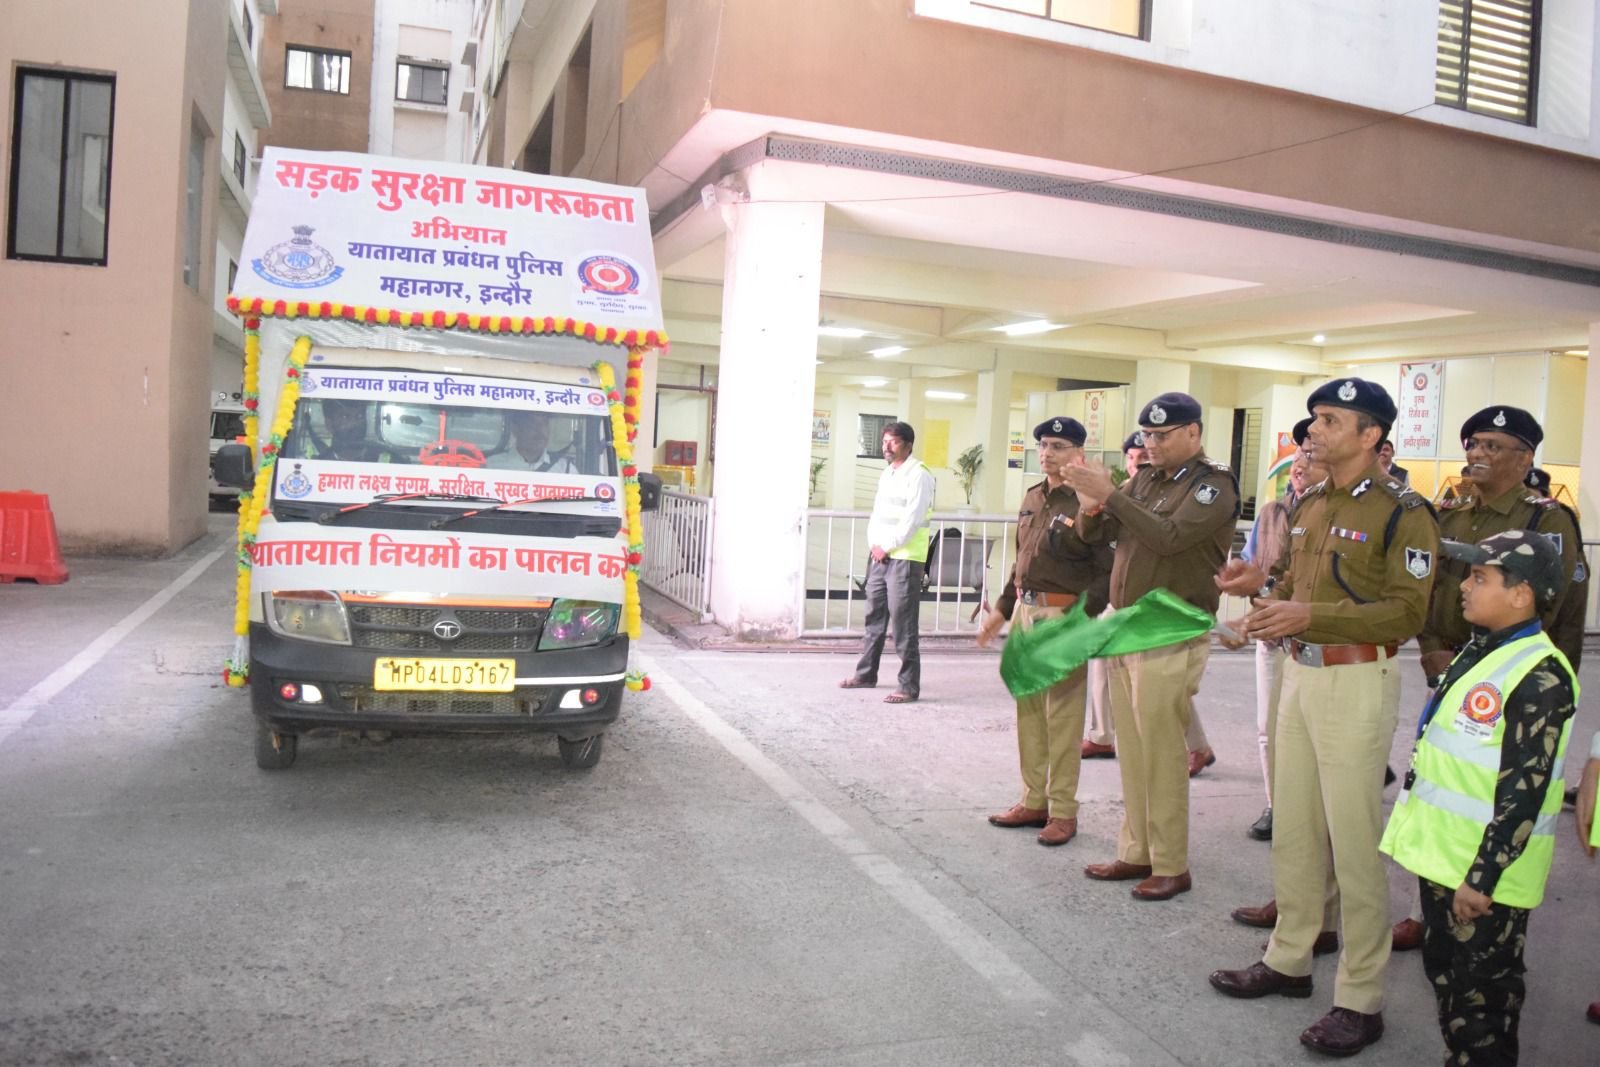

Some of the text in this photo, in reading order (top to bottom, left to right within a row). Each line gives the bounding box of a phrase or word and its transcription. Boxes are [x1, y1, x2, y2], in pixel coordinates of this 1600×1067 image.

[276, 160, 634, 223] सड़क सुरक्षा जागरूकता
[411, 216, 507, 245] अभियान
[348, 242, 436, 264] यातायात
[443, 244, 500, 270] प्रबंधन
[506, 251, 563, 279] पुलिस
[380, 276, 532, 305] महानगर, इन्दौर
[320, 375, 581, 405] यातायात प्रबंधन पुलिस महानगर, इन्दौर
[318, 473, 355, 492] हमारा
[359, 474, 391, 493] लक्ष्य
[244, 541, 361, 567] यातायात
[370, 533, 461, 569] नियमों
[469, 546, 508, 571] का
[515, 548, 592, 576] पालन
[391, 664, 510, 685] MP04LD3167
